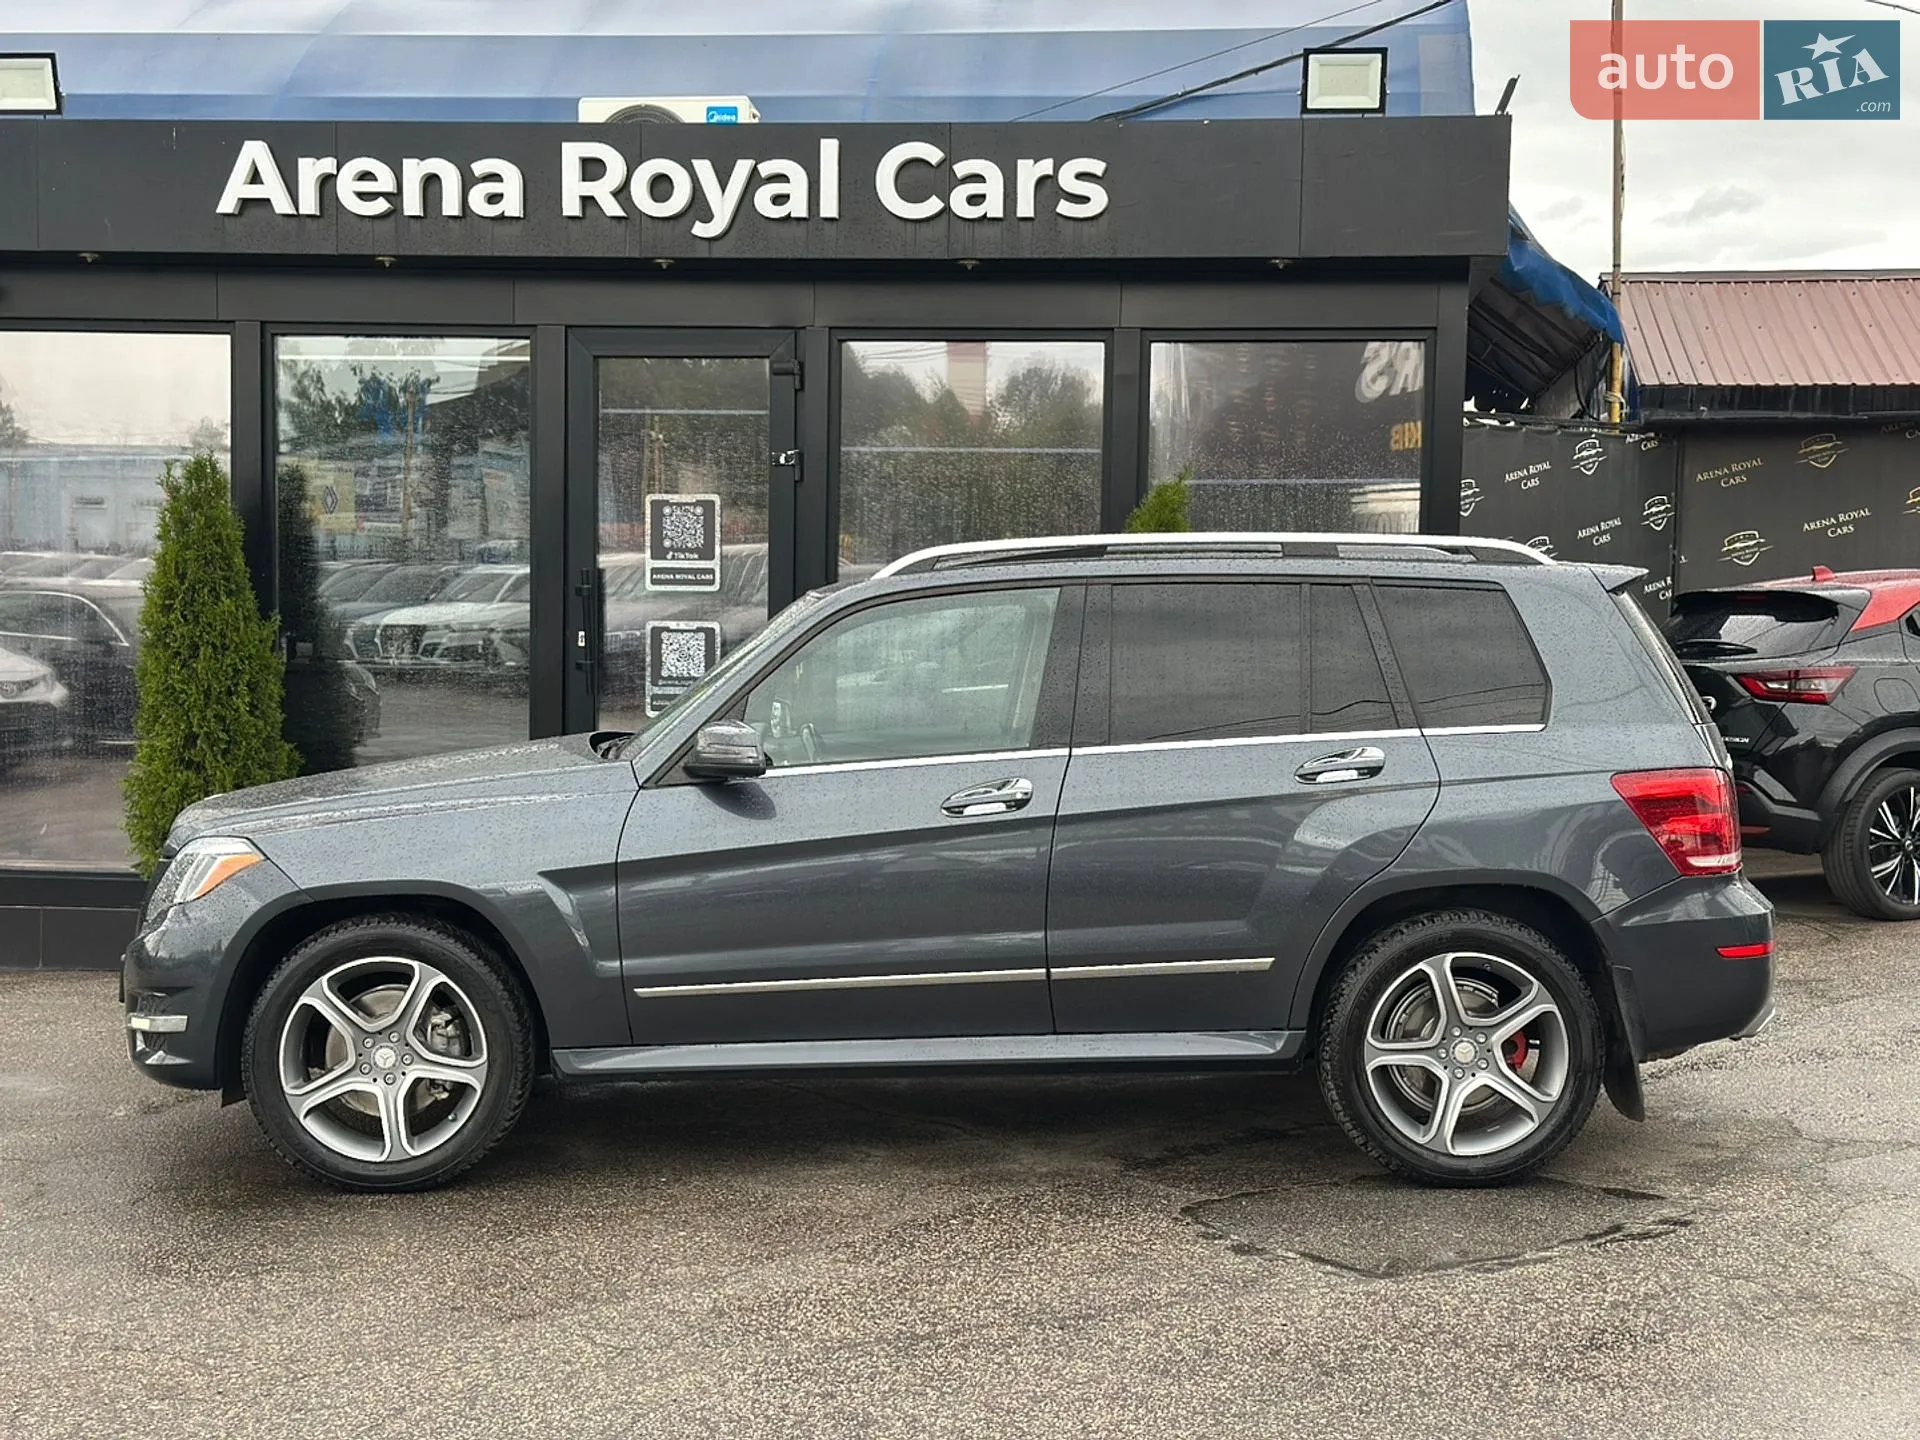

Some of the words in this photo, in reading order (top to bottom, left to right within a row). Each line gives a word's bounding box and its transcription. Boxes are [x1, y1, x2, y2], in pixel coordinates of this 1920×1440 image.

[216, 139, 525, 219] Arena
[560, 138, 841, 239] Royal
[875, 140, 1110, 221] Cars
[1504, 468, 1529, 483] ARENA
[1528, 461, 1552, 475] ROYAL
[1695, 467, 1729, 483] ARENA
[1731, 457, 1765, 474] ROYAL
[1720, 474, 1747, 488] CARS
[1521, 477, 1540, 490] CARS
[1577, 526, 1601, 540] ARENA
[1600, 516, 1622, 531] ROYAL
[1802, 515, 1837, 532] ARENA
[1838, 507, 1872, 523] ROYAL
[1592, 532, 1611, 546] CARS
[1827, 524, 1855, 538] CARS
